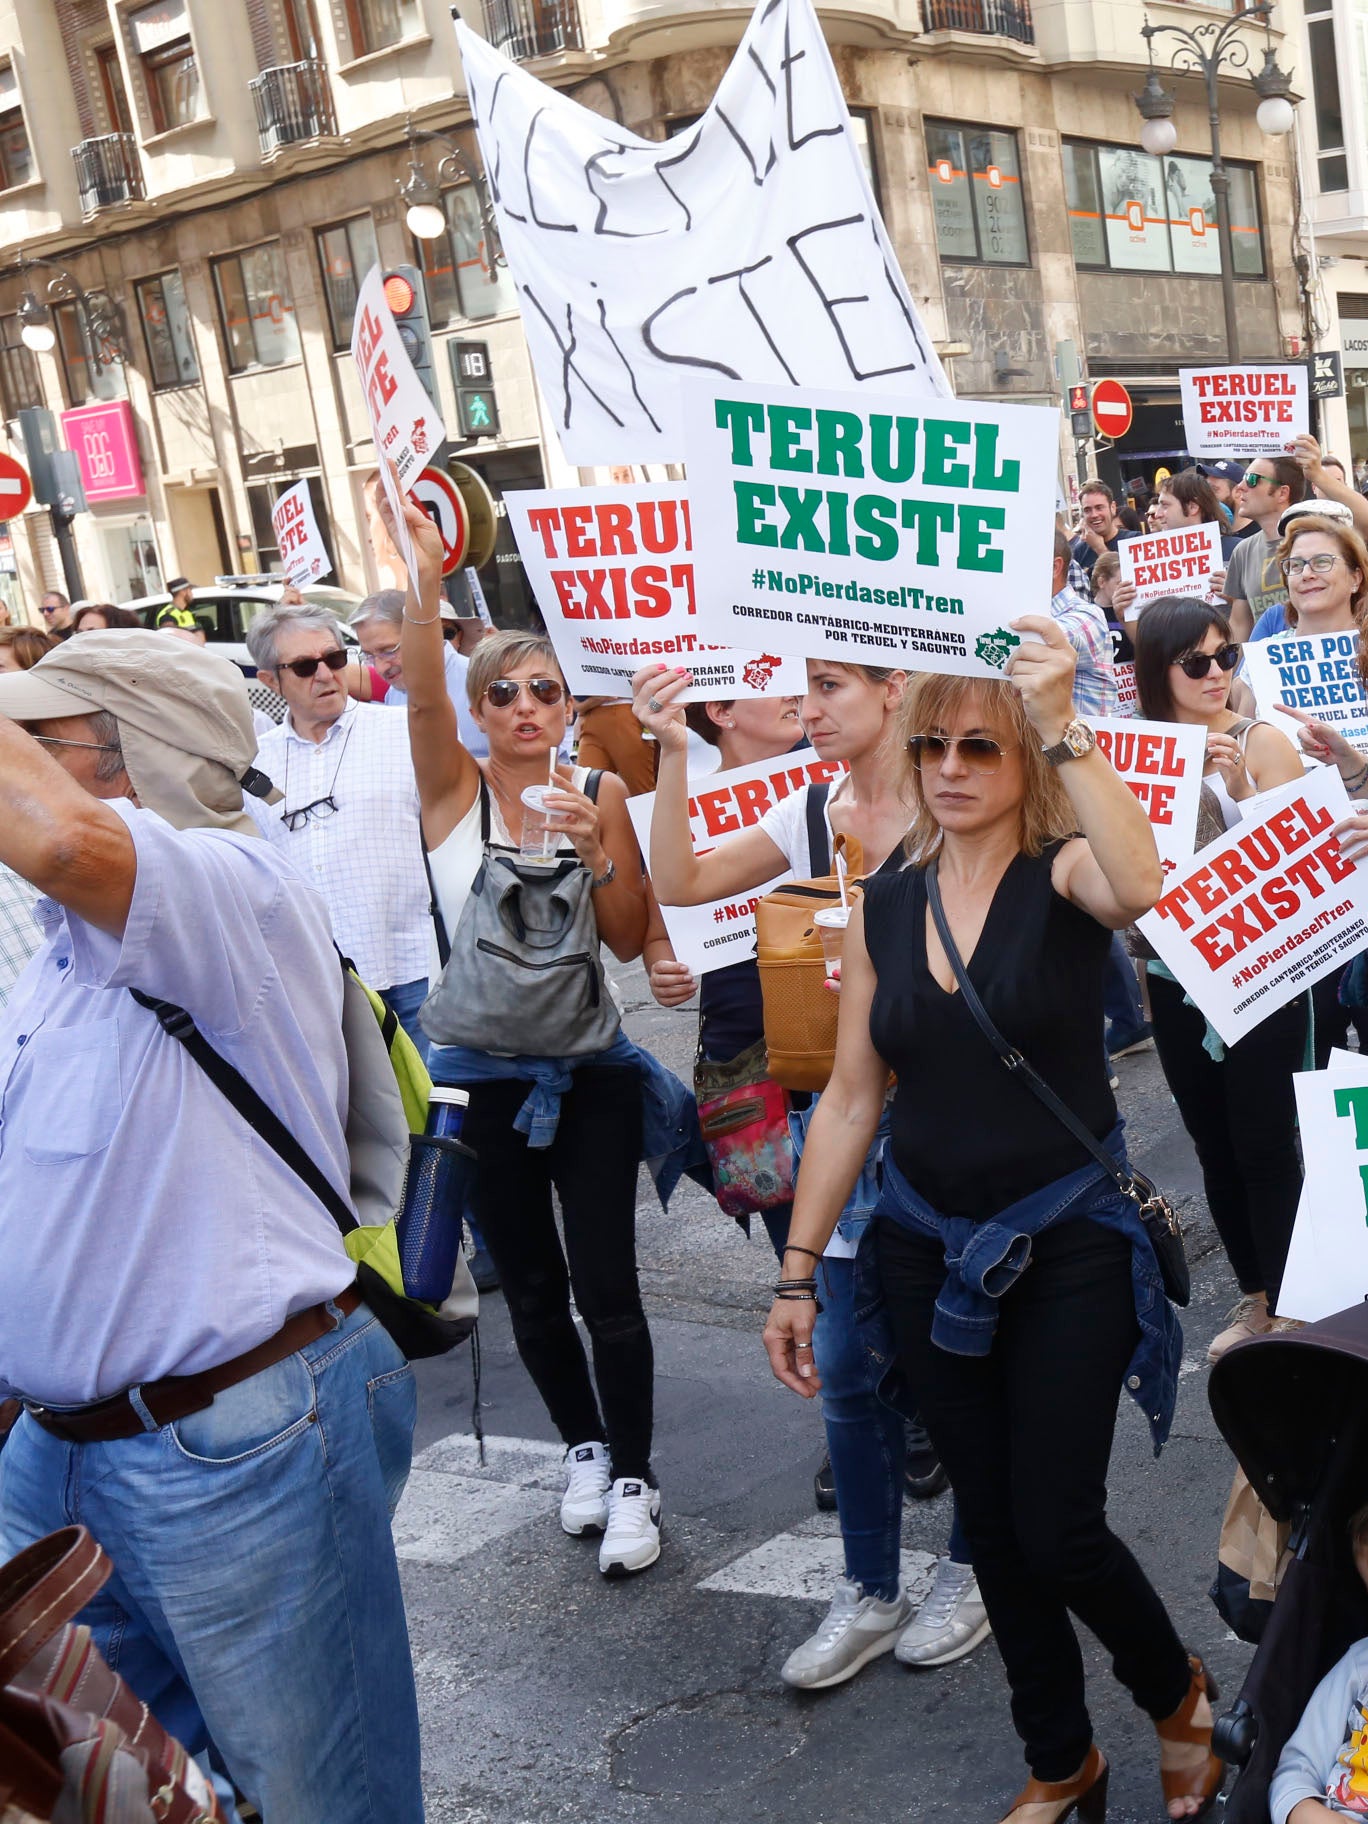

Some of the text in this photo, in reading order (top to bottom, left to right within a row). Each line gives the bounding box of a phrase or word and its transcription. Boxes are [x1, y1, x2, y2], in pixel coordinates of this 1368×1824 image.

[464, 352, 487, 377] 18
[1193, 374, 1296, 397] TERUEL
[1200, 400, 1293, 423] EXISTE
[714, 398, 1020, 493] TERUEL
[1207, 429, 1280, 438] #NoPierdaselTren
[733, 480, 1006, 573] EXISTE
[1129, 531, 1212, 563] TERUEL
[1134, 555, 1210, 587] EXISTE
[752, 569, 964, 615] #NoPierdaselTren
[732, 605, 966, 644] CORREDOR CANTÁBRICO-MEDITERRÁNEO
[825, 629, 968, 657] POR TERUEL Y SAGUNTO
[1267, 641, 1315, 665] SER
[1278, 665, 1311, 687] NO
[1154, 797, 1335, 932] TERUEL
[1190, 837, 1357, 972] EXISTE
[703, 929, 750, 949] CORREDOR
[1232, 899, 1354, 989] #NoPierdaselTren
[1233, 919, 1365, 1015] CORREDOR CANTÁBRICO-MEDITERRÁNEO
[1290, 970, 1305, 984] POR
[1305, 953, 1331, 973] TERUEL
[1332, 948, 1339, 957] Y
